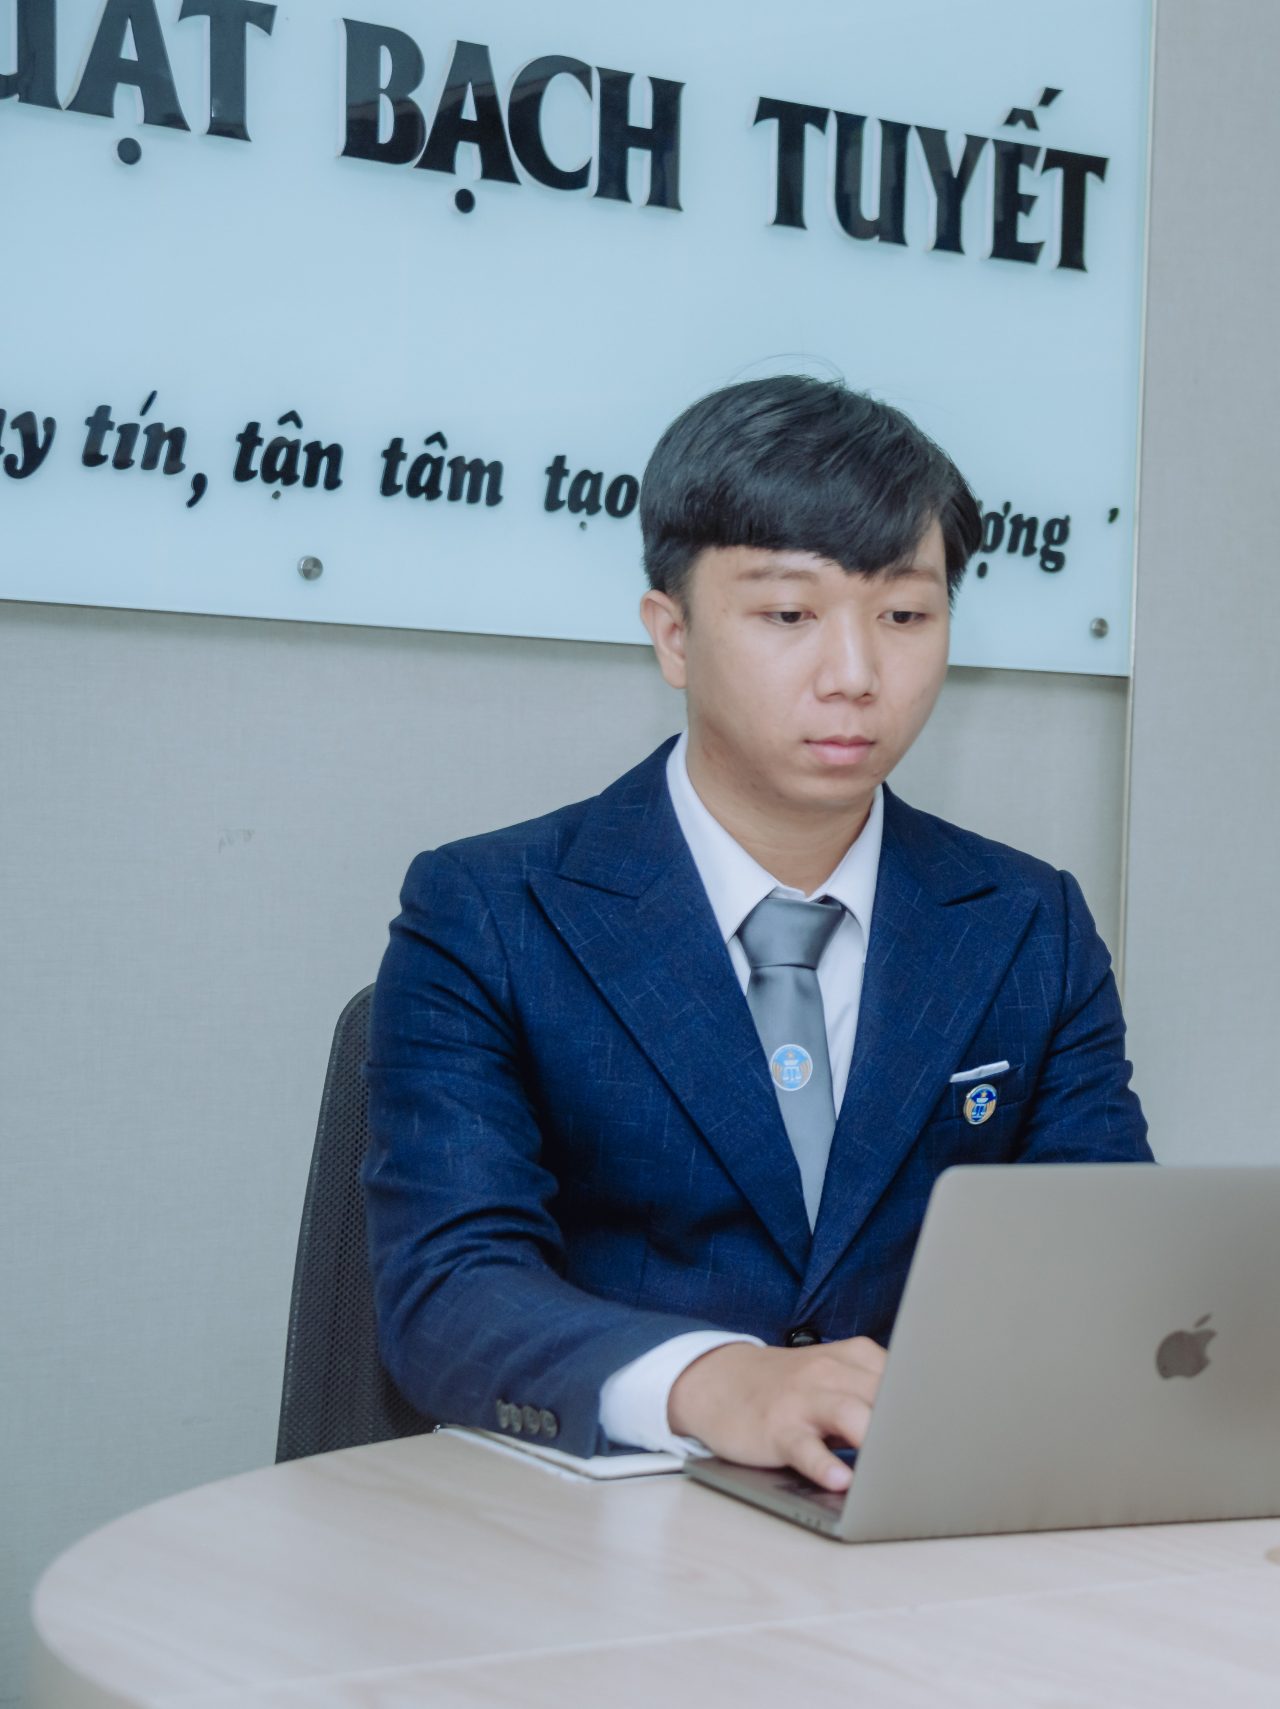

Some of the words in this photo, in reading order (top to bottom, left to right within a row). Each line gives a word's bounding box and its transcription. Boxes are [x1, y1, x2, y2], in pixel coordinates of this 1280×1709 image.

[340, 17, 686, 214] BẠCH
[753, 87, 1109, 272] TUYẾT
[0, 408, 56, 480] y
[82, 390, 208, 508] tín,
[233, 410, 344, 500] tận
[380, 431, 503, 507] tâm
[544, 454, 641, 532] tạo
